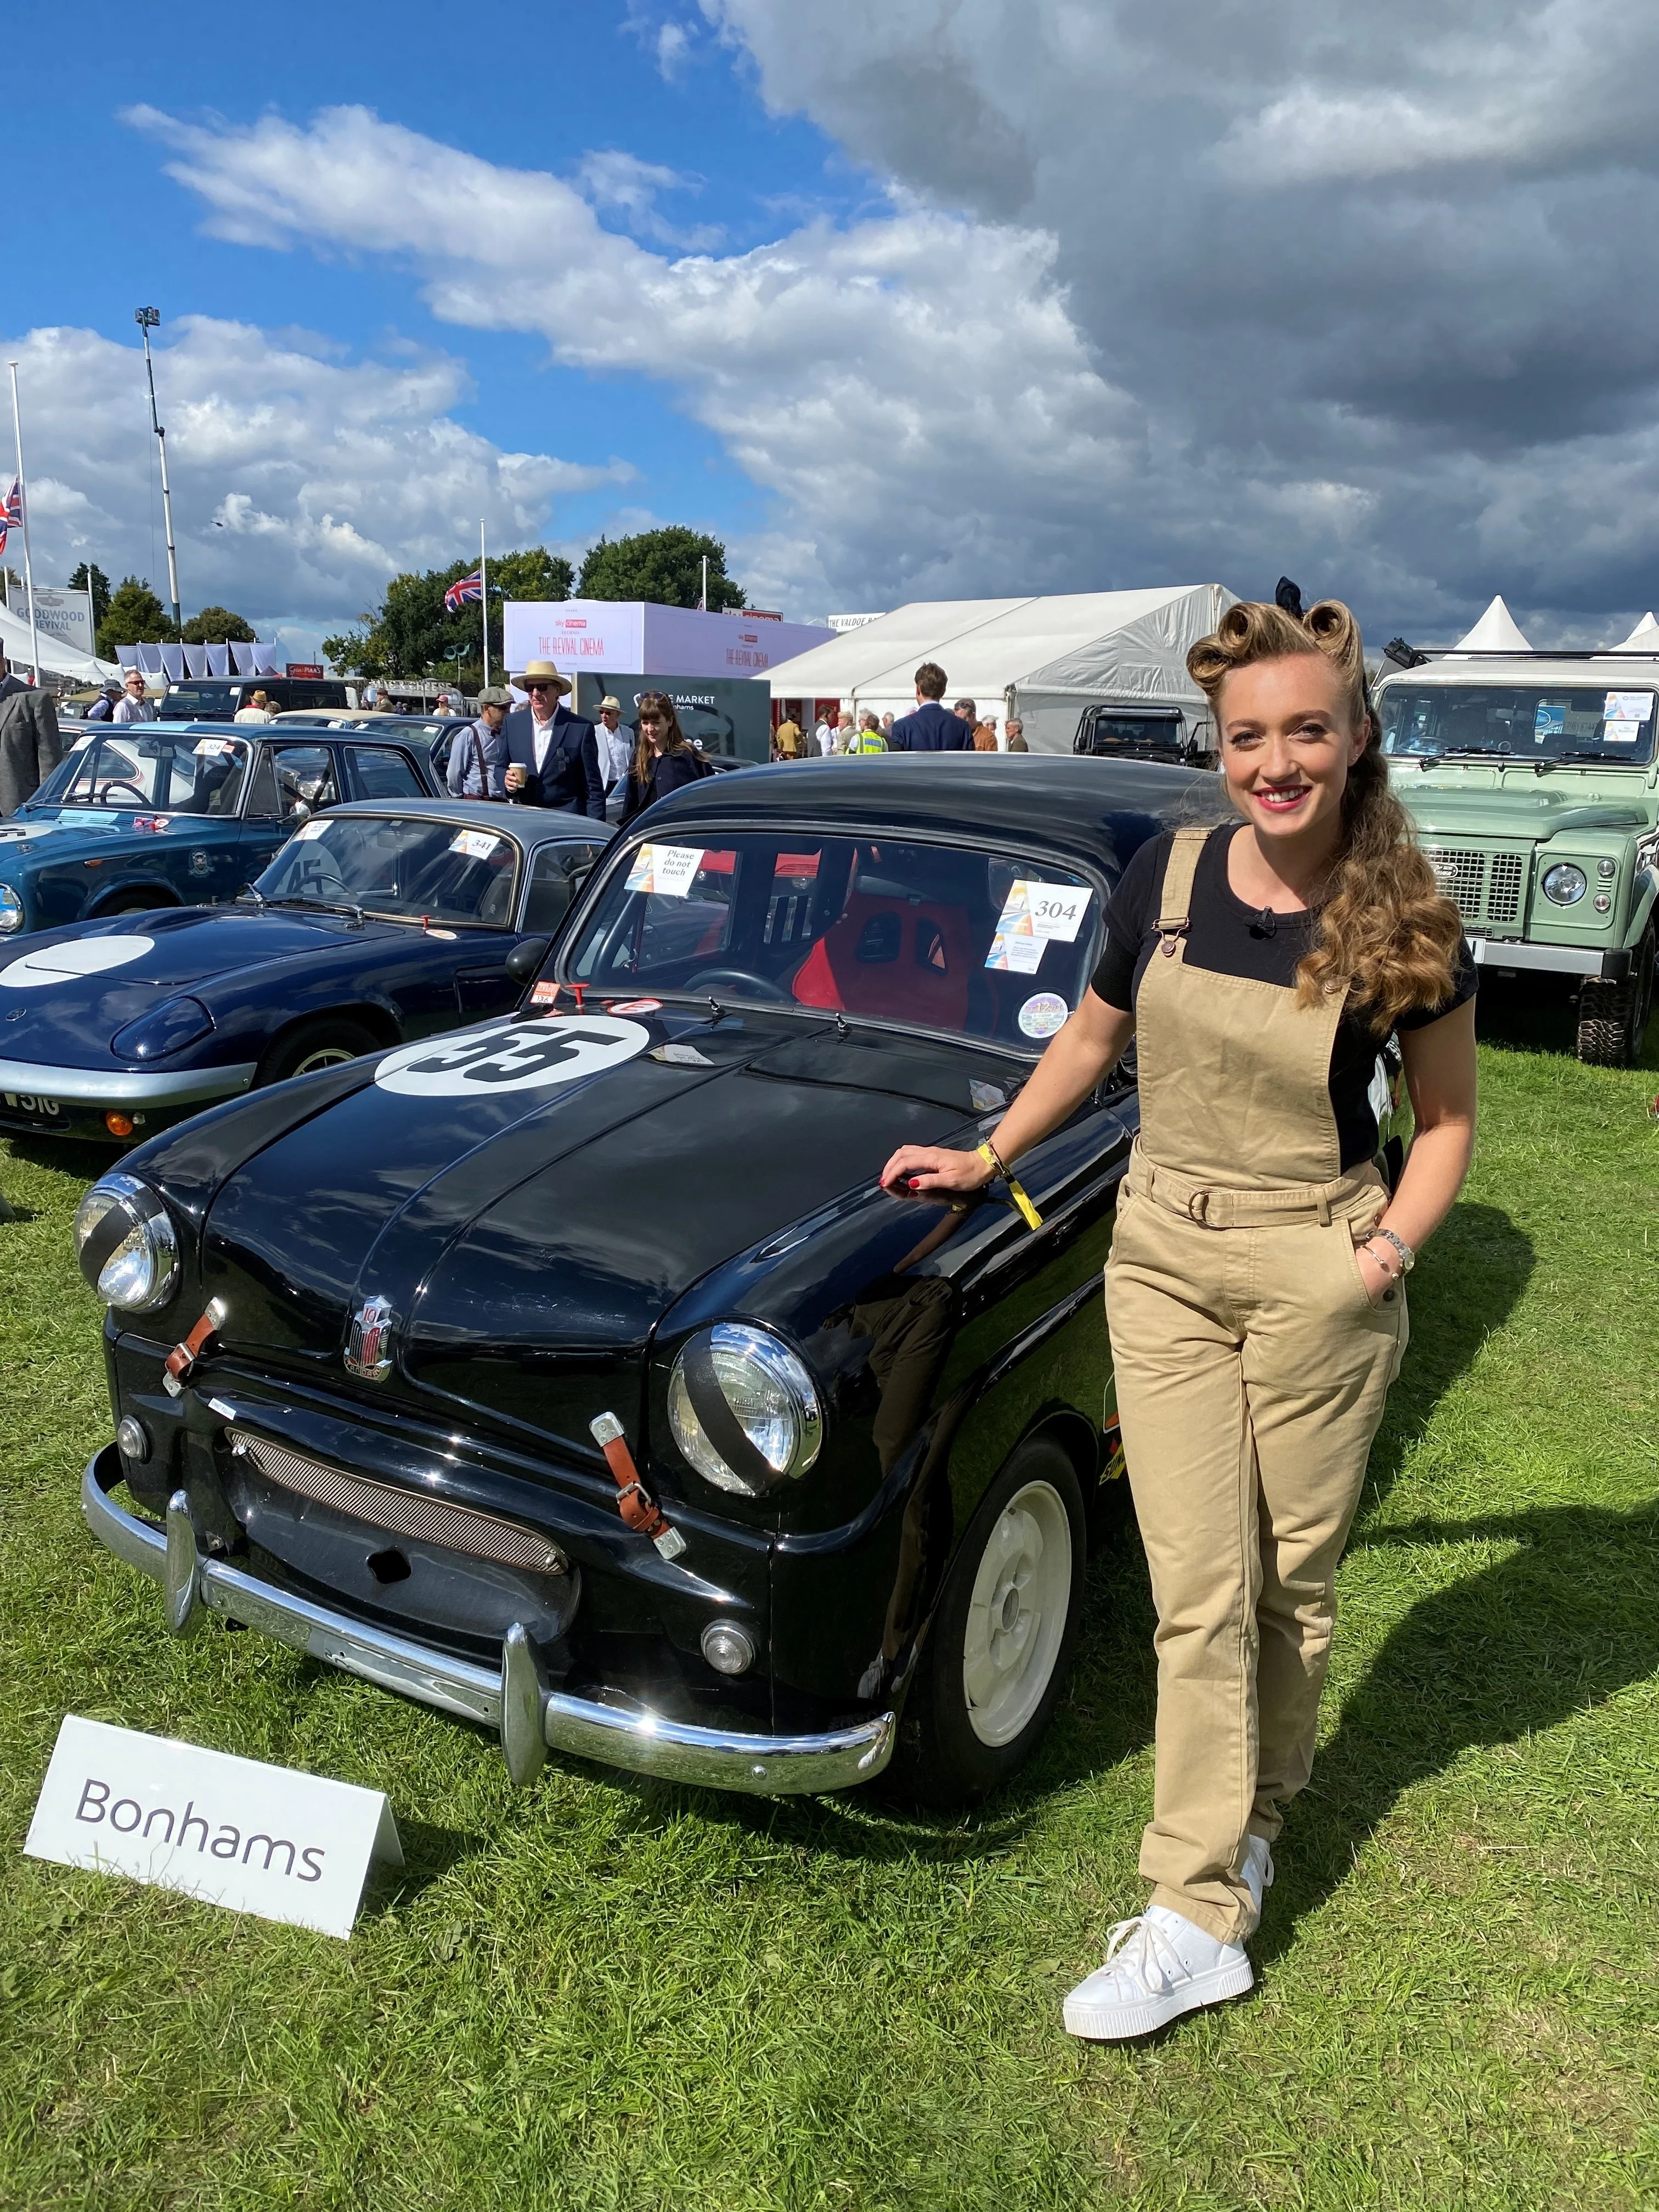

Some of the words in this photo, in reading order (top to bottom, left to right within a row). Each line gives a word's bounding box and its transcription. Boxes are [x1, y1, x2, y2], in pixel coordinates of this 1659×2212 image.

[16, 607, 84, 622] GOODWOOD
[830, 619, 839, 628] THE
[539, 637, 550, 654] THE
[552, 637, 578, 655] REVIVAL
[580, 637, 604, 656] CINEMA
[676, 695, 715, 704] MARKET
[472, 840, 492, 850] 341
[667, 850, 695, 860] Please
[664, 858, 675, 866] do
[662, 867, 686, 876] touch
[1035, 900, 1077, 920] 304
[407, 1025, 629, 1082] 55
[364, 1307, 377, 1323] 10
[75, 1778, 326, 1882] Bonhams
